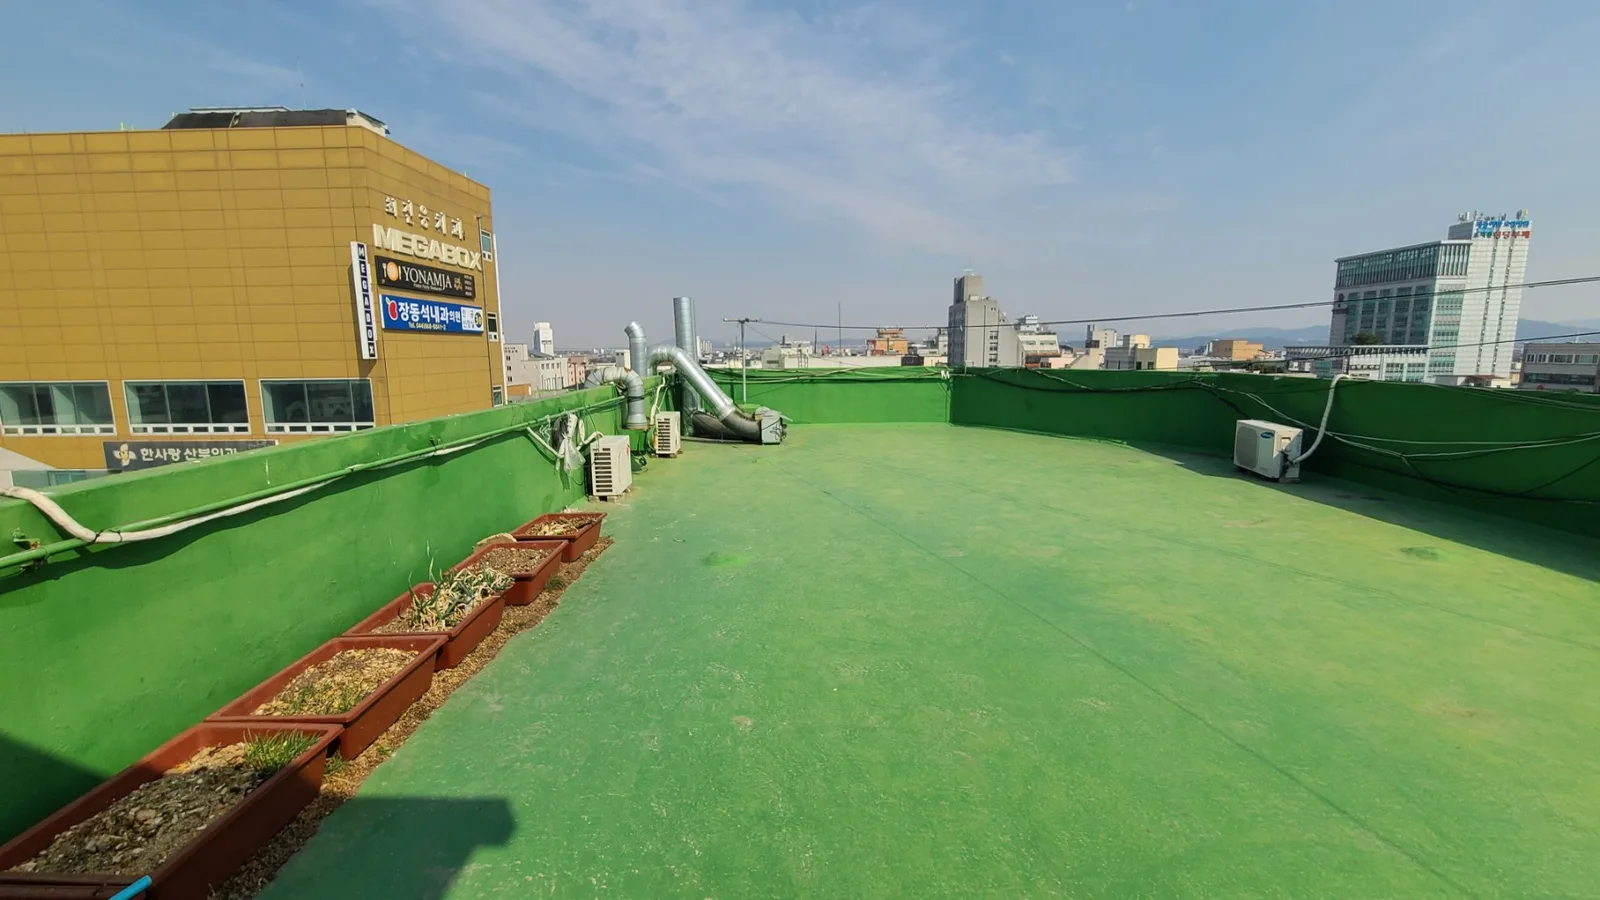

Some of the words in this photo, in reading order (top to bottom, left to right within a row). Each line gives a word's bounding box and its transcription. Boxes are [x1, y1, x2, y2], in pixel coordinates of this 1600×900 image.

[373, 223, 482, 271] MEGABOX
[402, 265, 452, 290] YONAMJA
[357, 245, 375, 355] MEGABOX
[140, 447, 181, 462] 한사랑
